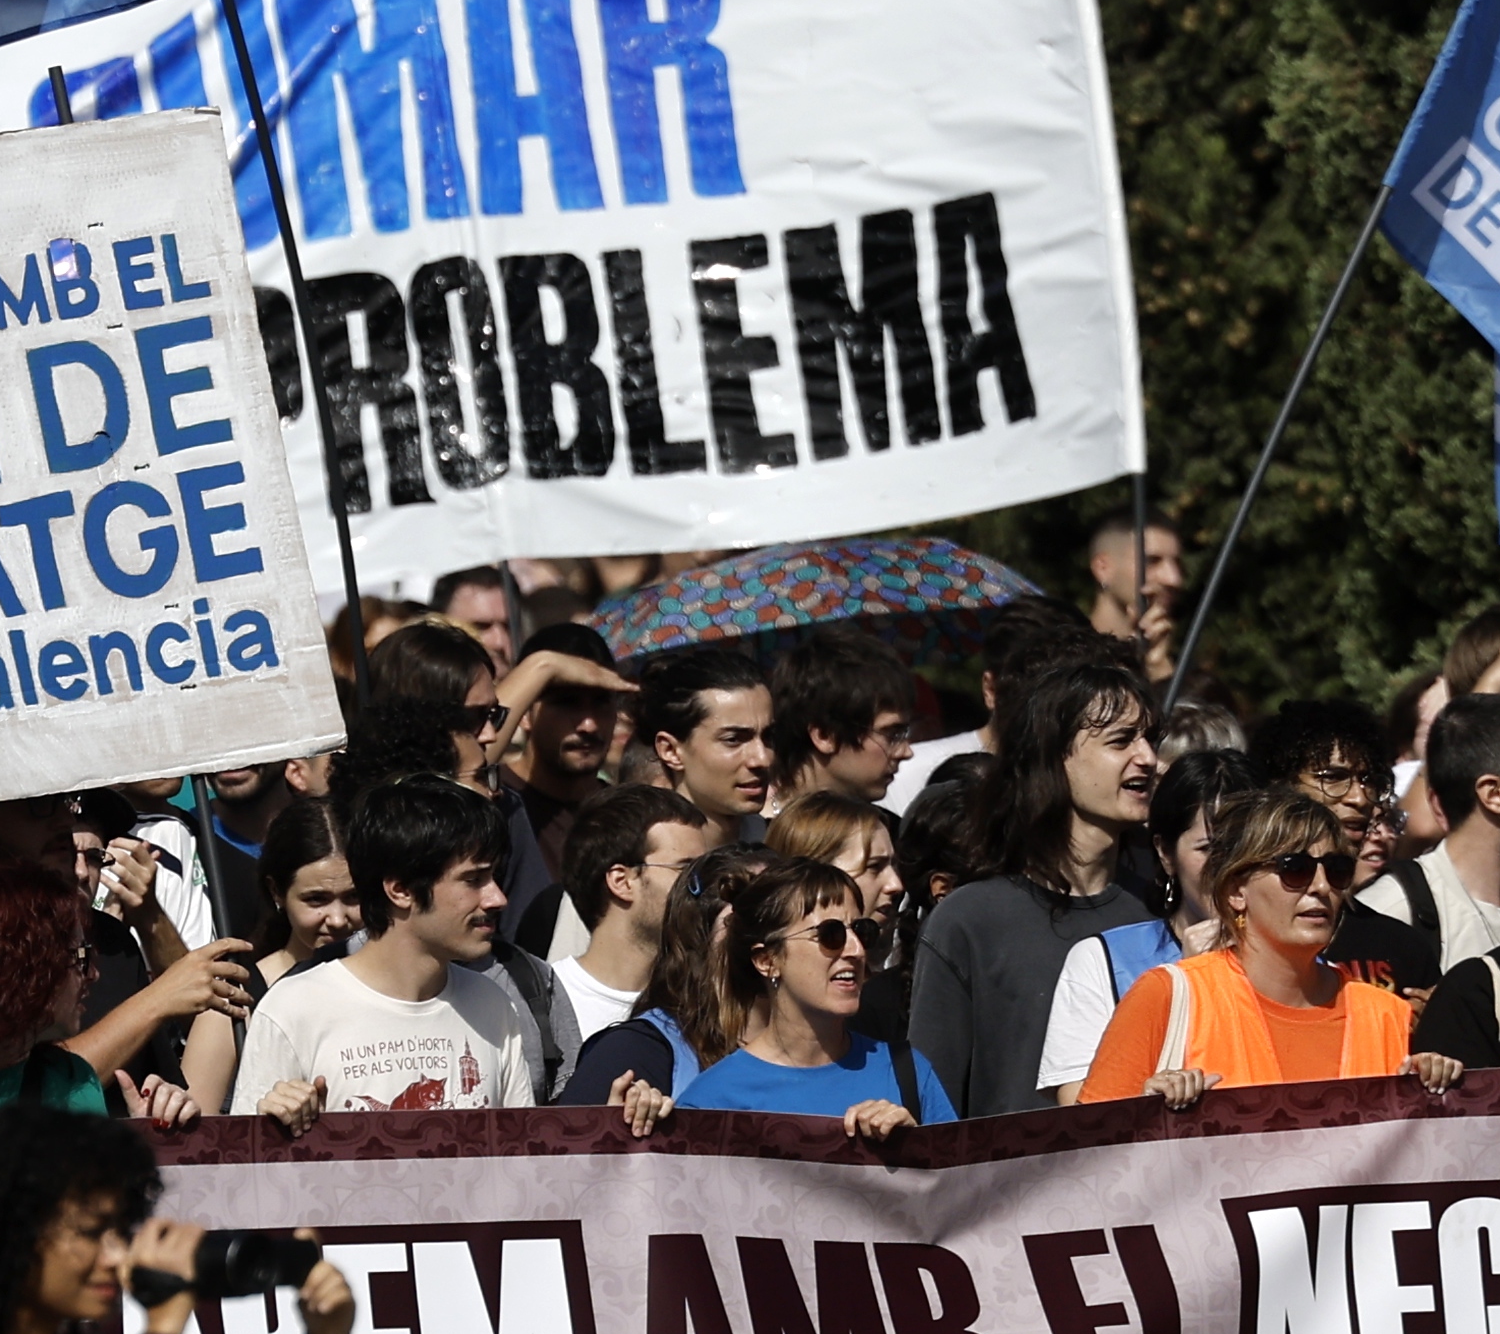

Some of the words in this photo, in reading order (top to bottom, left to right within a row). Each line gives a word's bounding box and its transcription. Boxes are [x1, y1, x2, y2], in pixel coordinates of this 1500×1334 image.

[112, 233, 211, 312] EL
[26, 316, 234, 474] DE
[340, 1048, 354, 1062] NI
[357, 1044, 376, 1057] UN
[379, 1040, 405, 1055] PAM
[407, 1035, 454, 1052] D'HORTA
[343, 1064, 368, 1080] PER
[371, 1059, 393, 1075] ALS
[395, 1056, 448, 1071] VOLTORS
